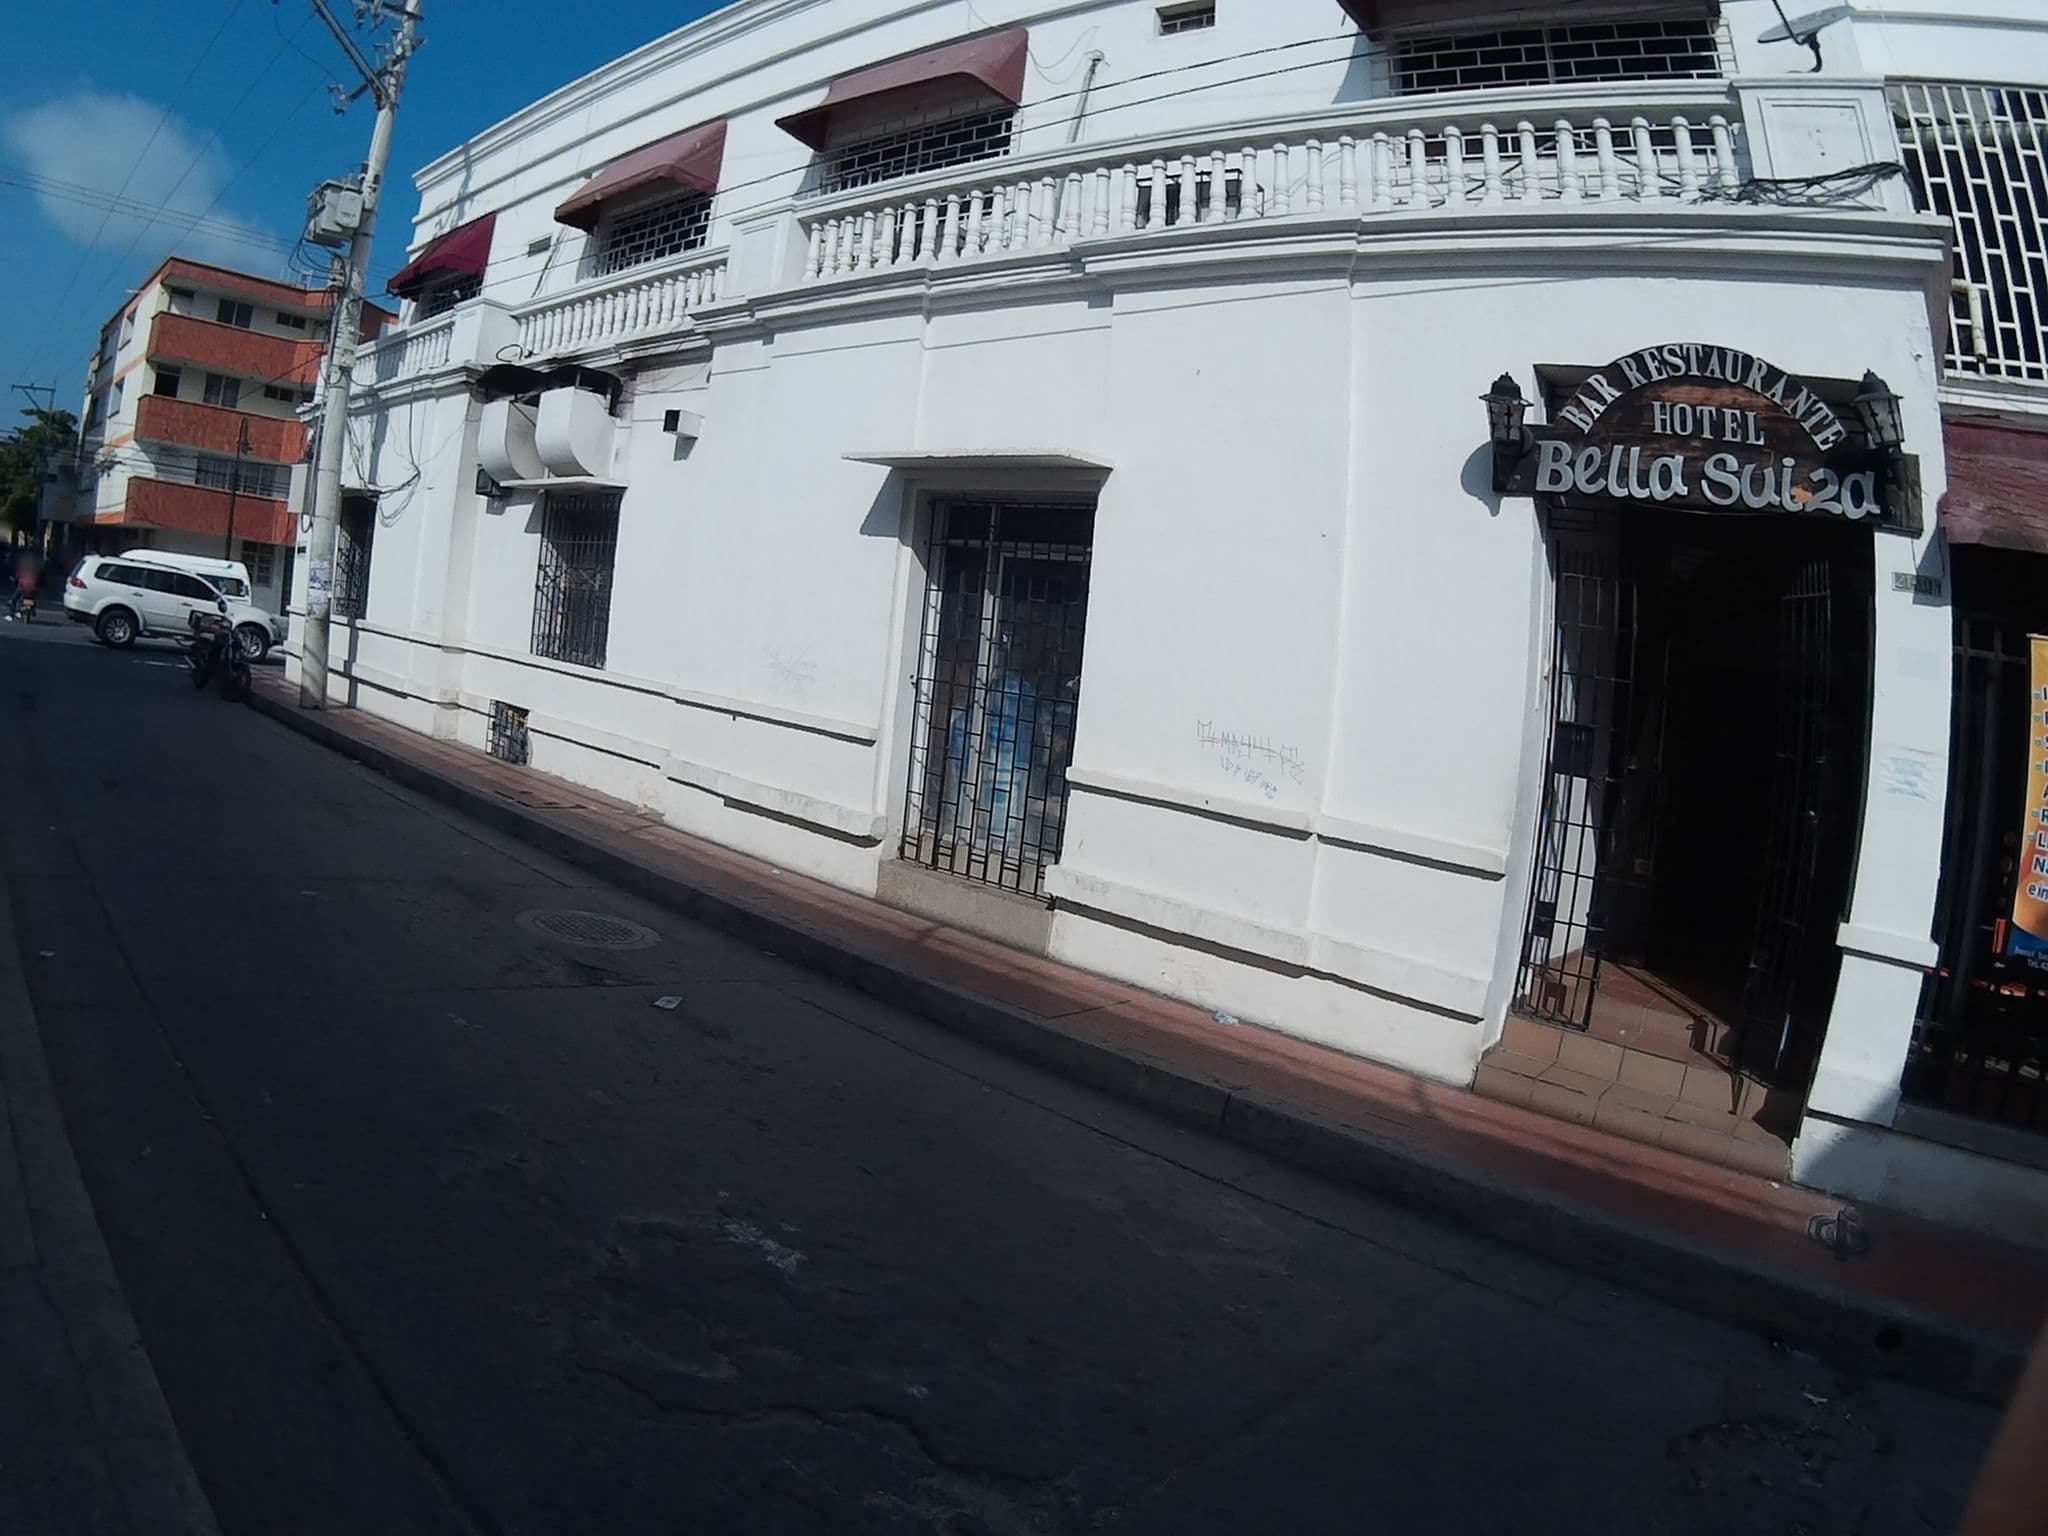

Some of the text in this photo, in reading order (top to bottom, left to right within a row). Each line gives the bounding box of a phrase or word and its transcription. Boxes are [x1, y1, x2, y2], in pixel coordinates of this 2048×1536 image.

[1559, 344, 1848, 451] BAR RESTAURANTE
[1651, 400, 1766, 446] HOTEL
[1535, 440, 1689, 501] Bella
